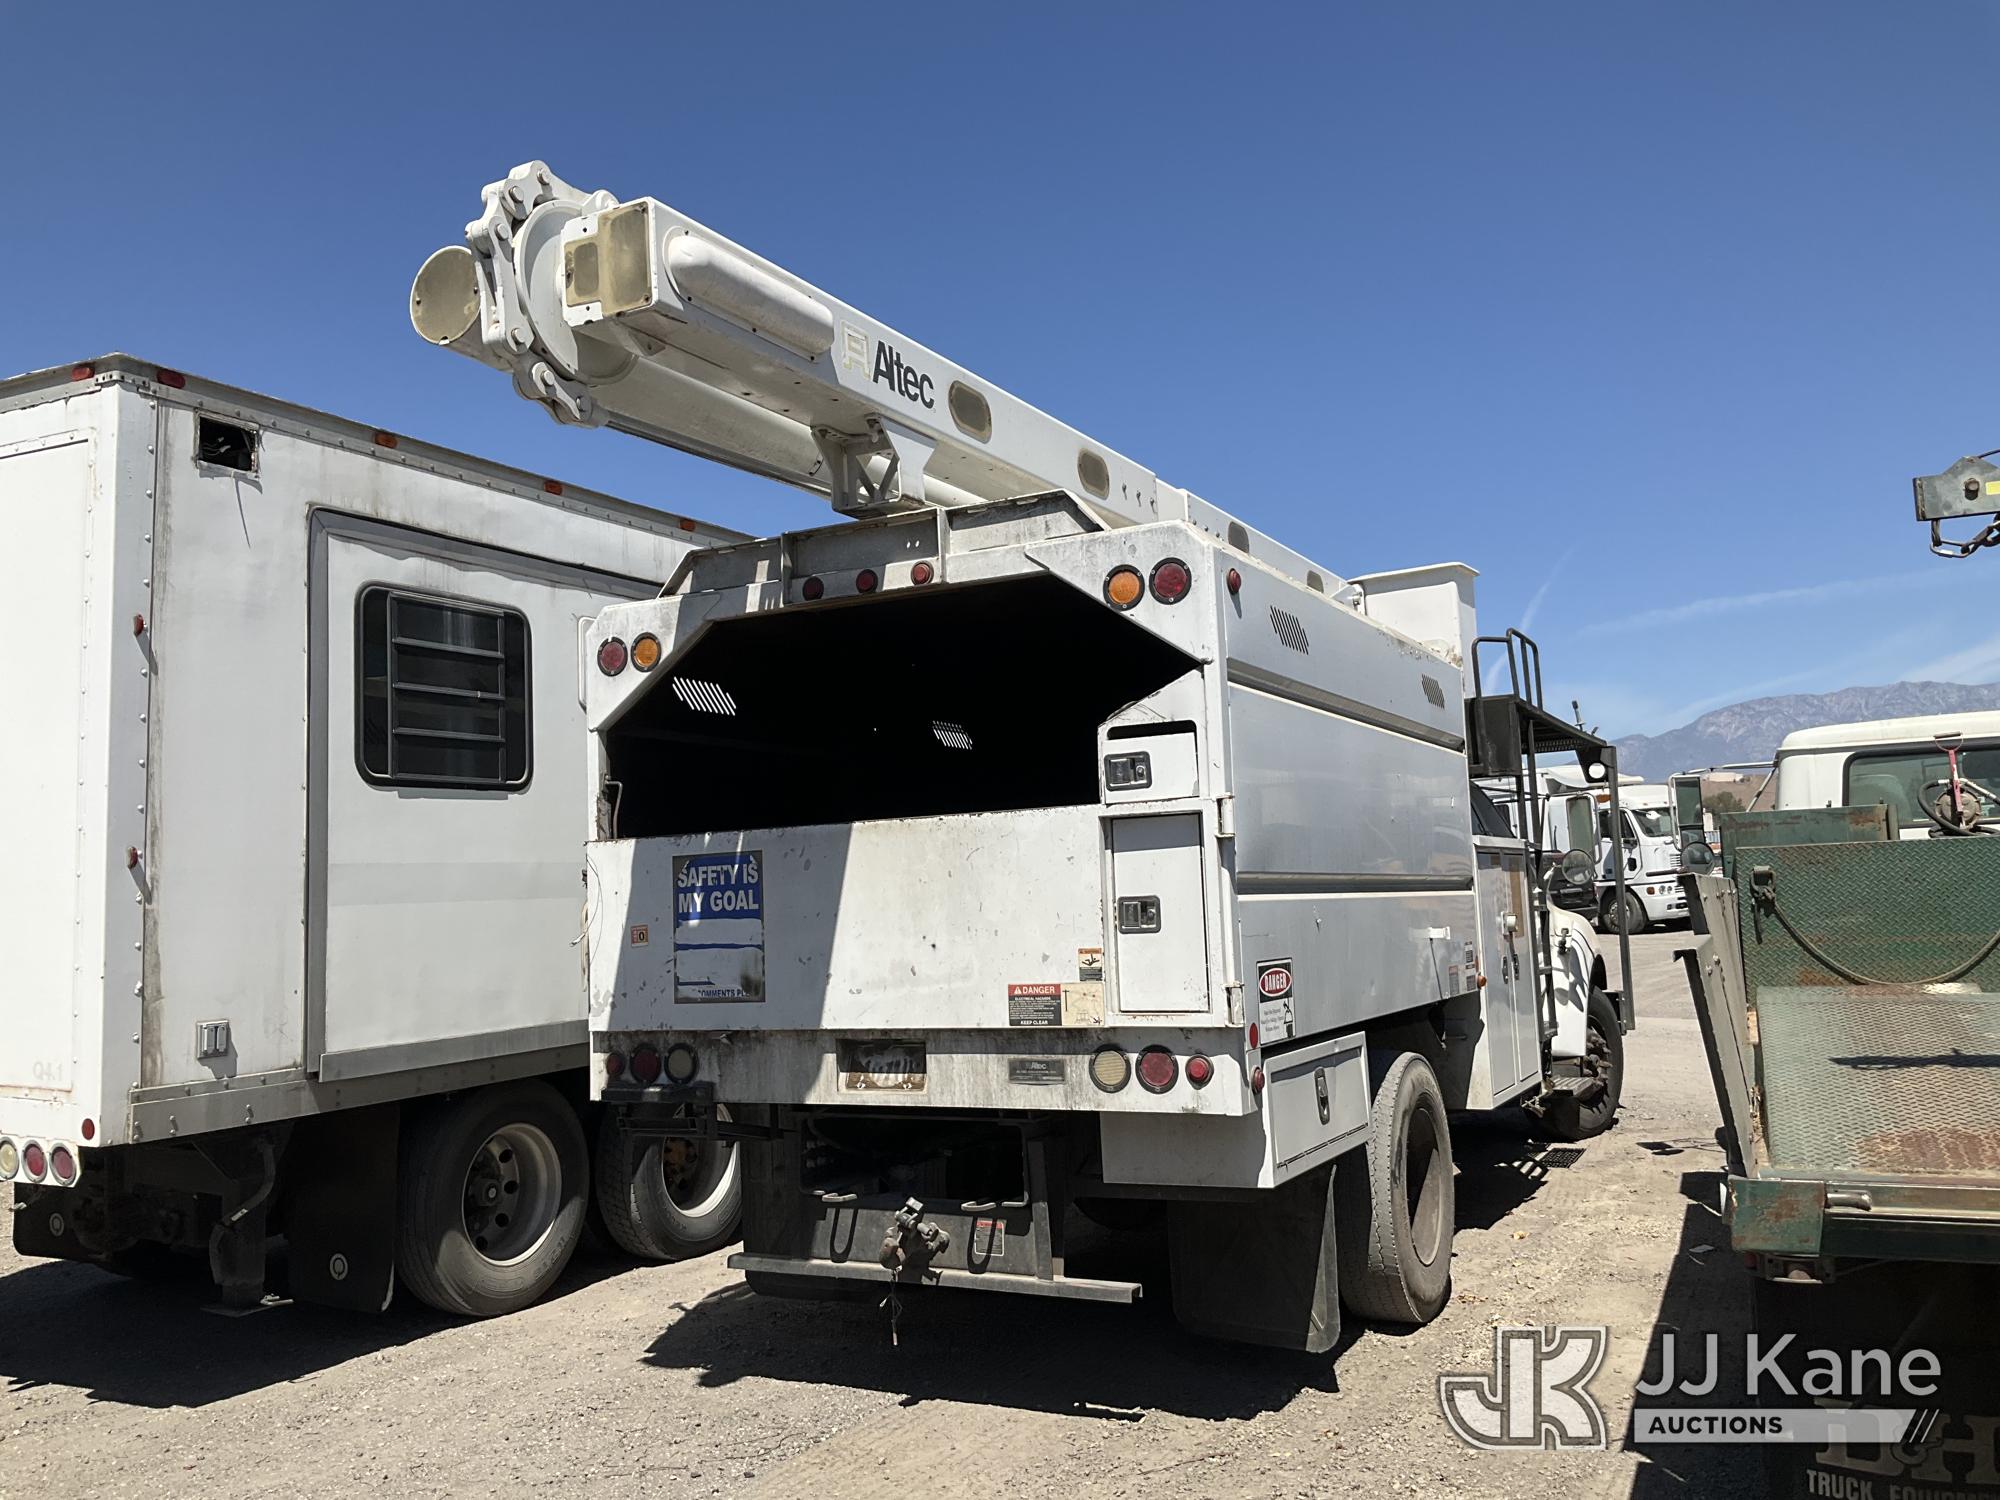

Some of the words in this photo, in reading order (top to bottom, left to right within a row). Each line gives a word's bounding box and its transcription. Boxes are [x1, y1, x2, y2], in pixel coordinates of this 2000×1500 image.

[872, 339, 935, 409] Altec
[677, 864, 739, 888] SAFETY
[743, 862, 759, 885] IS
[678, 892, 704, 913] MY
[710, 889, 760, 912] GOAL
[698, 988, 736, 998] OMMENTS
[1022, 986, 1056, 995] DANGER
[1264, 972, 1287, 992] DANGER
[1806, 1467, 1874, 1500] TRUCK
